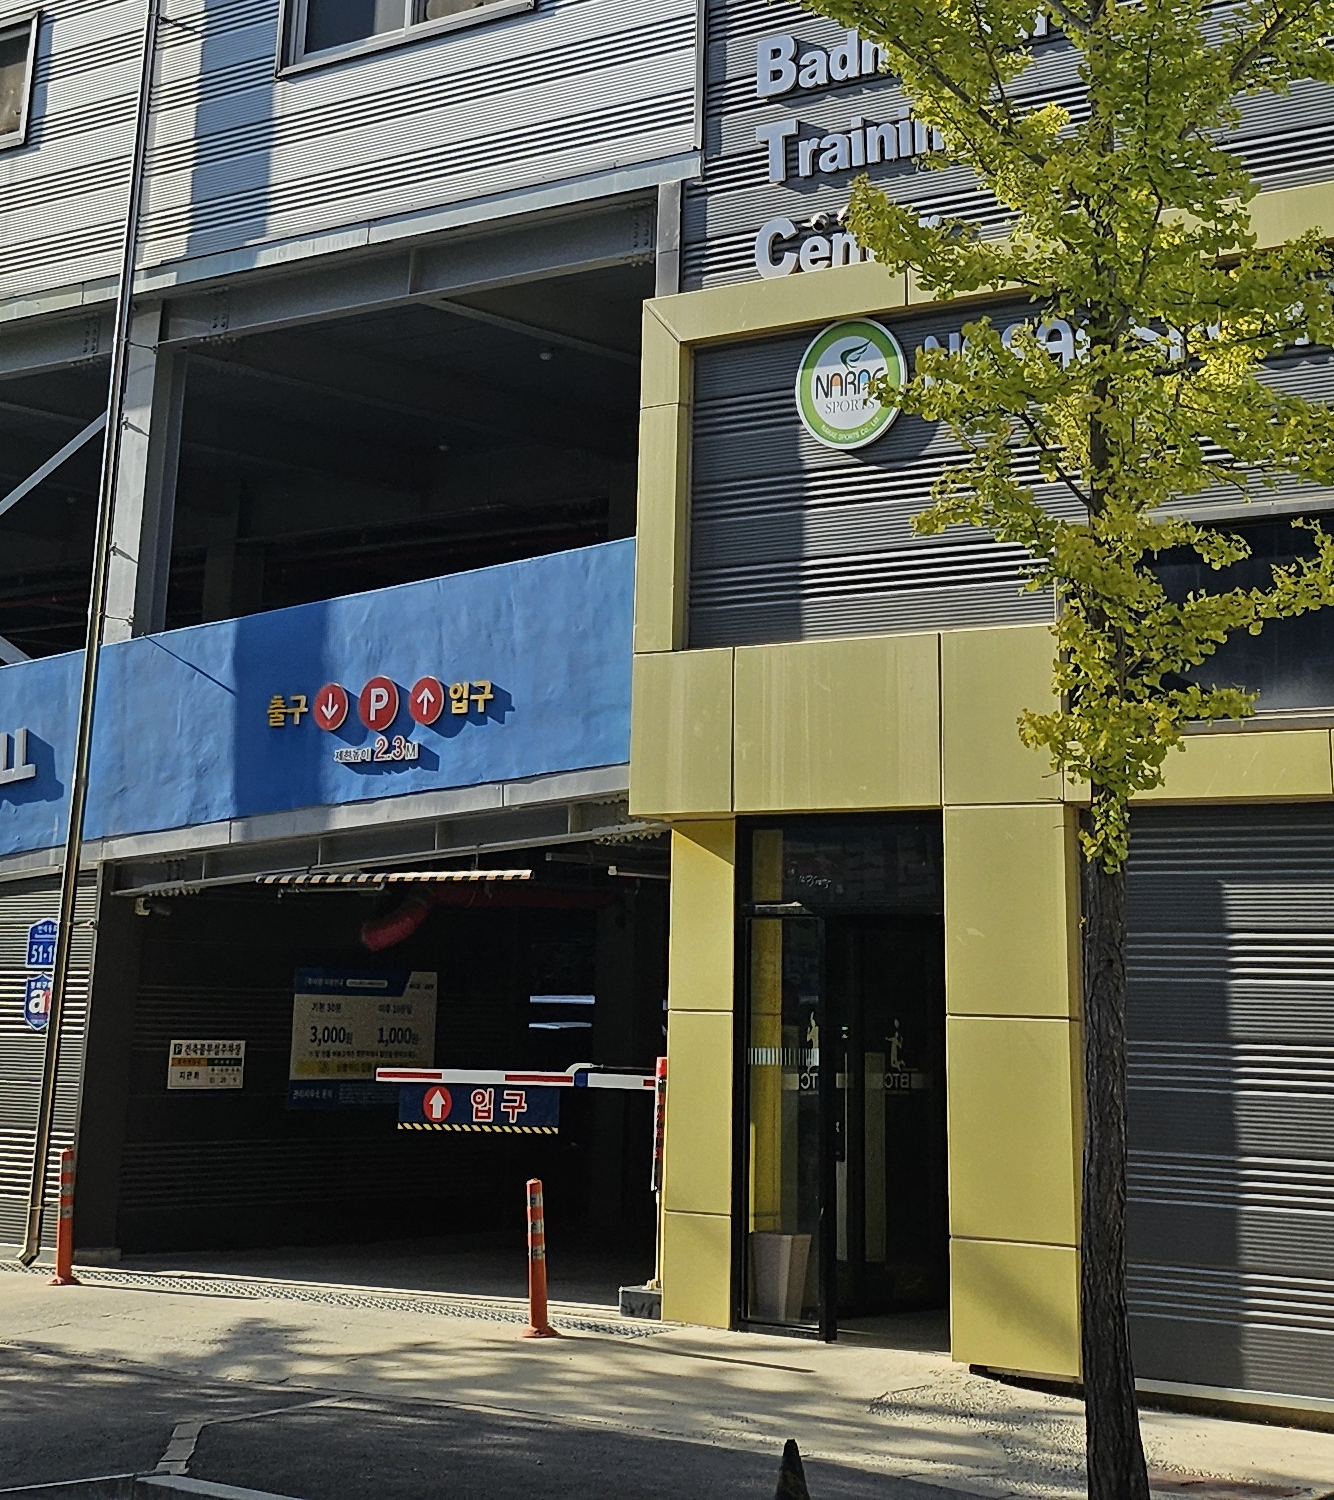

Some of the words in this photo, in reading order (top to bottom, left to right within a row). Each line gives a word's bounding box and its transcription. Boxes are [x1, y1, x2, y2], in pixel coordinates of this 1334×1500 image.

[755, 106, 946, 185] Trainin
[268, 694, 308, 727] 출구
[369, 687, 390, 722] P
[448, 680, 495, 714] 입구
[334, 747, 371, 762] 제한높이
[470, 1087, 528, 1124] 입구
